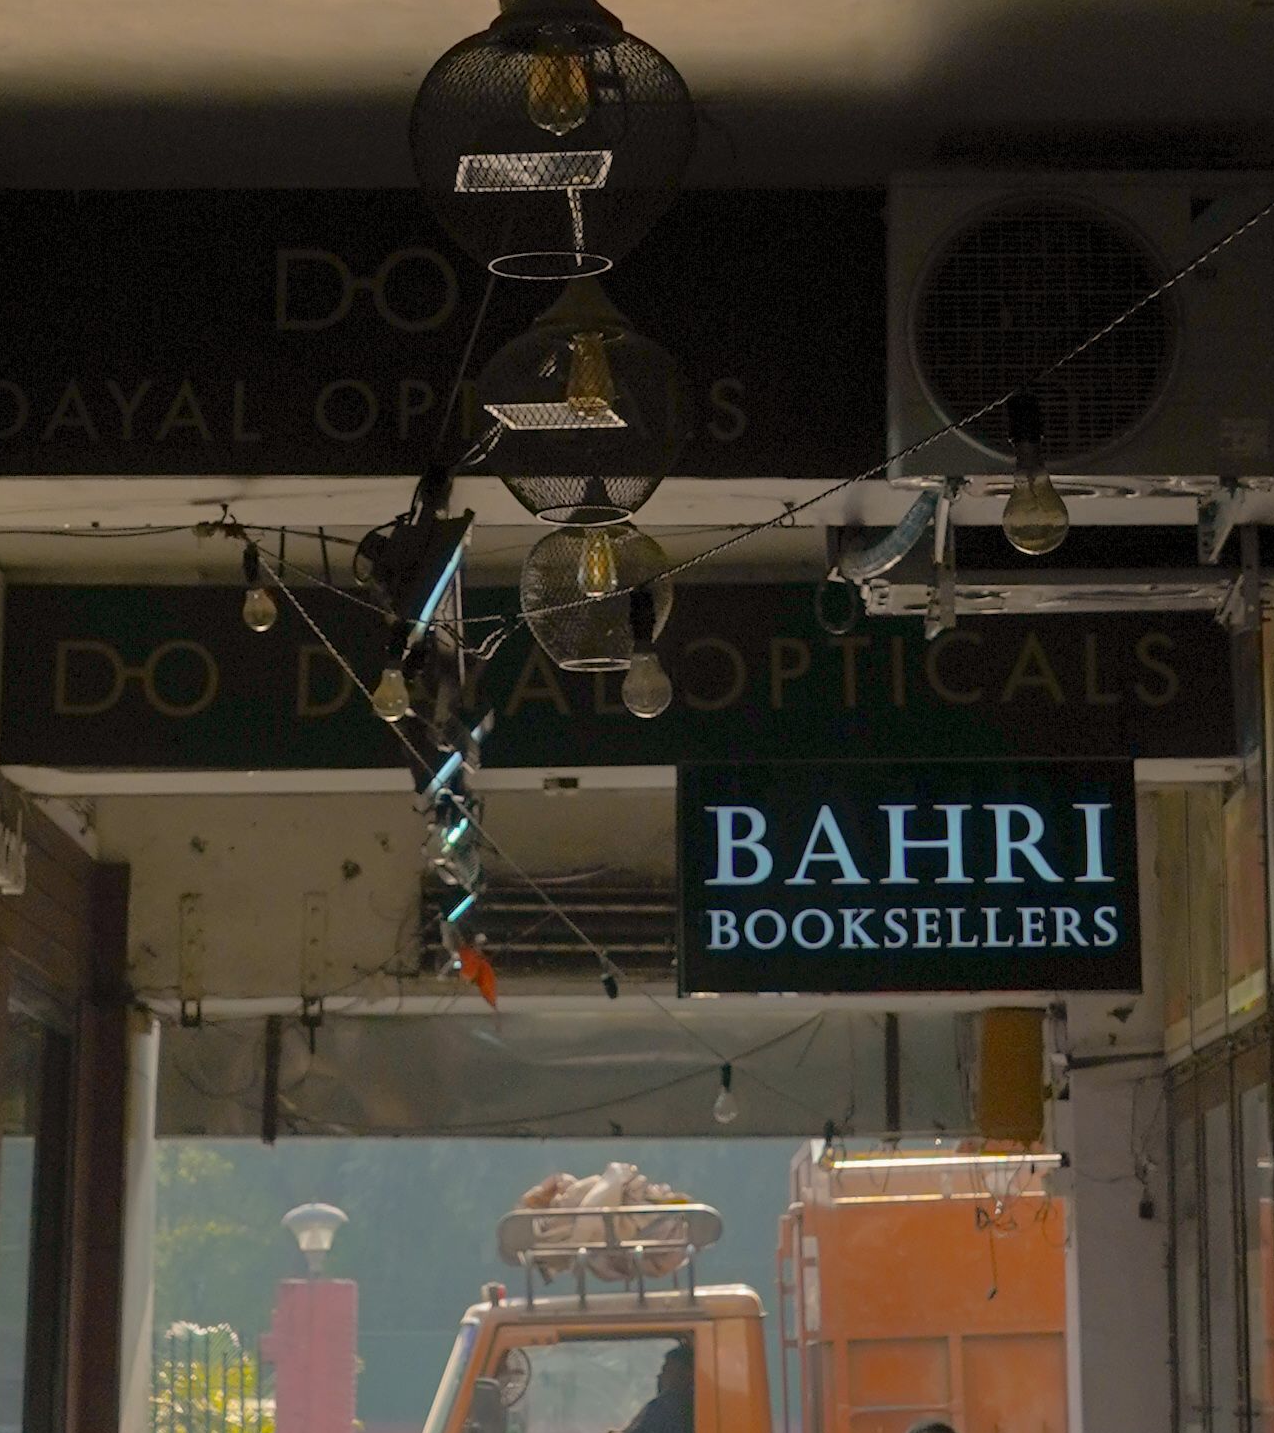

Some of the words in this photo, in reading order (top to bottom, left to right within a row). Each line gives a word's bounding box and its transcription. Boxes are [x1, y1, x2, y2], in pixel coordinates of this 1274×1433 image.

[686, 628, 1182, 713] OPTICALS
[703, 801, 1117, 886] BAHRI
[705, 904, 1120, 952] BOOKSELLERS
